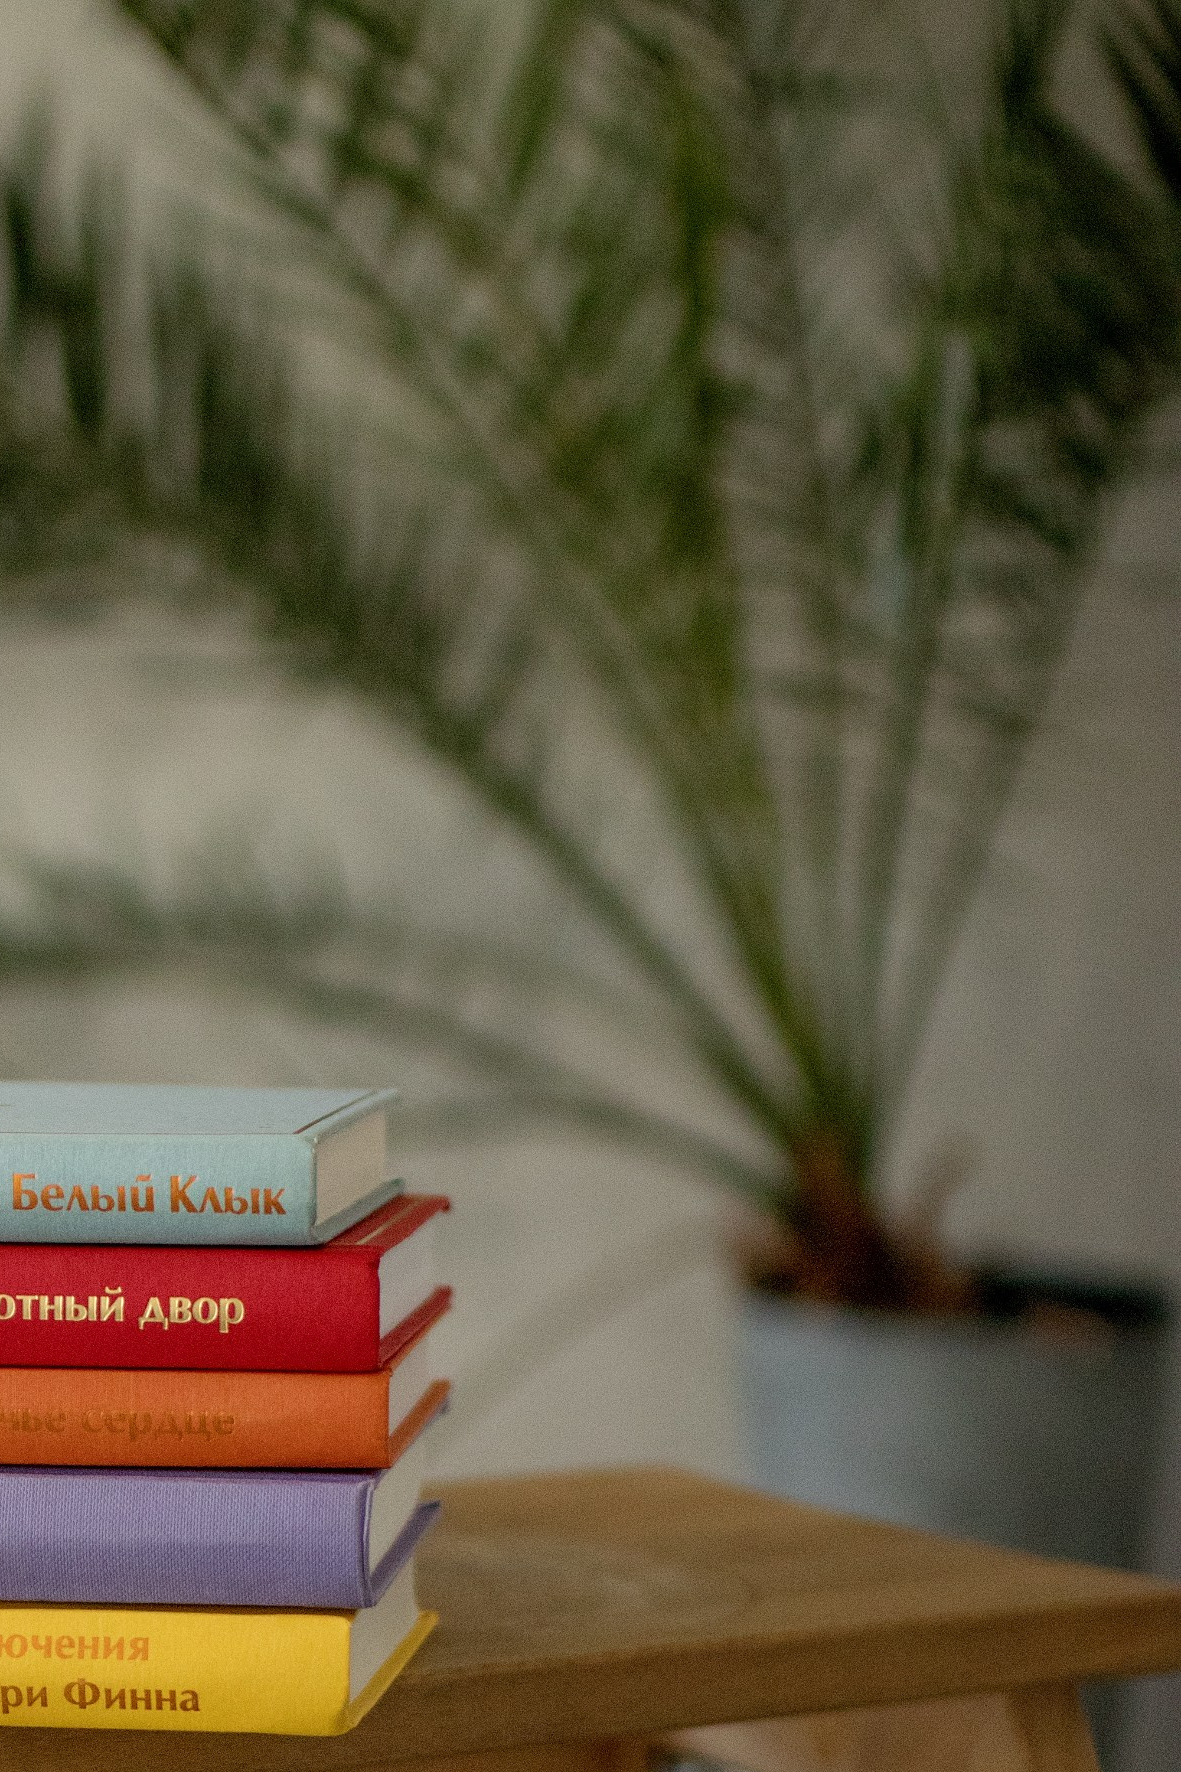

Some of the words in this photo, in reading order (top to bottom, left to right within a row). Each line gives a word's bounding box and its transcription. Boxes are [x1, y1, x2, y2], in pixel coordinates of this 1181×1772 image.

[11, 1173, 154, 1213] Белый
[170, 1175, 286, 1215] Клык
[138, 1293, 245, 1332] двор
[82, 1406, 235, 1442] сердце
[63, 1677, 201, 1712] Финна
